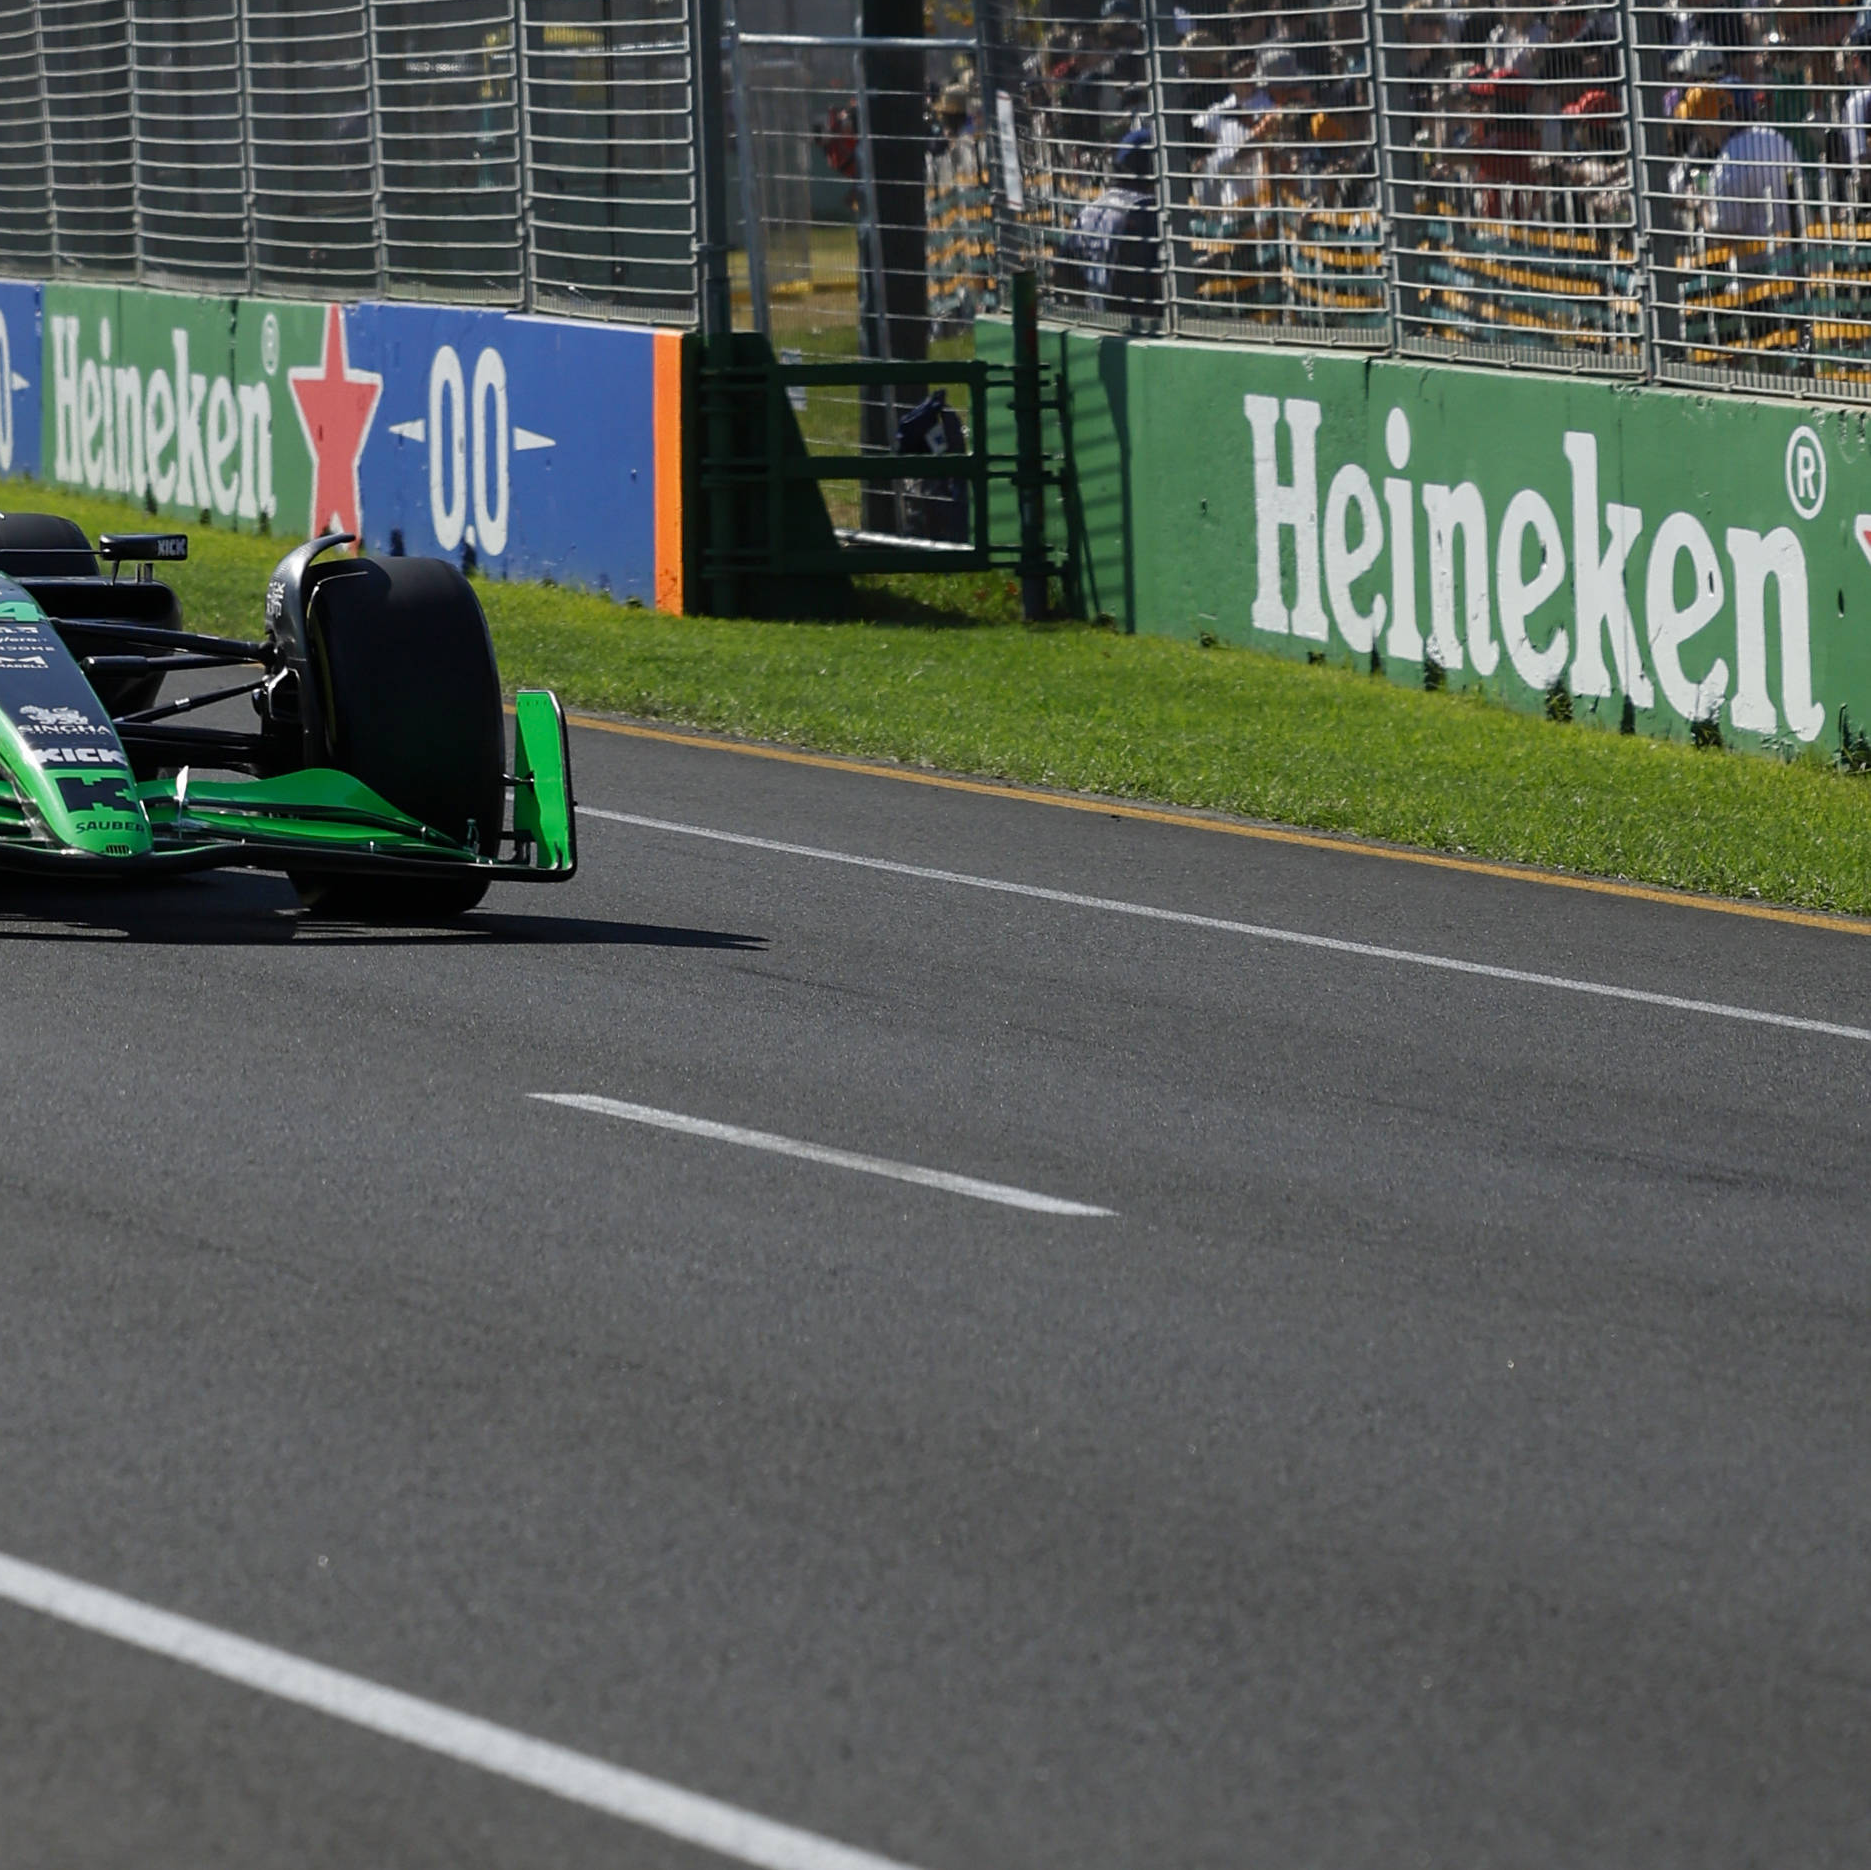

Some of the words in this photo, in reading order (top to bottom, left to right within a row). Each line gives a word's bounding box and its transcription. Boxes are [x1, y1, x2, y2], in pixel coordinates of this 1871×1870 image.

[50, 315, 277, 520] Heineken
[1243, 393, 1827, 742] Heineken
[18, 724, 112, 736] SINGHA
[33, 747, 128, 766] KICK
